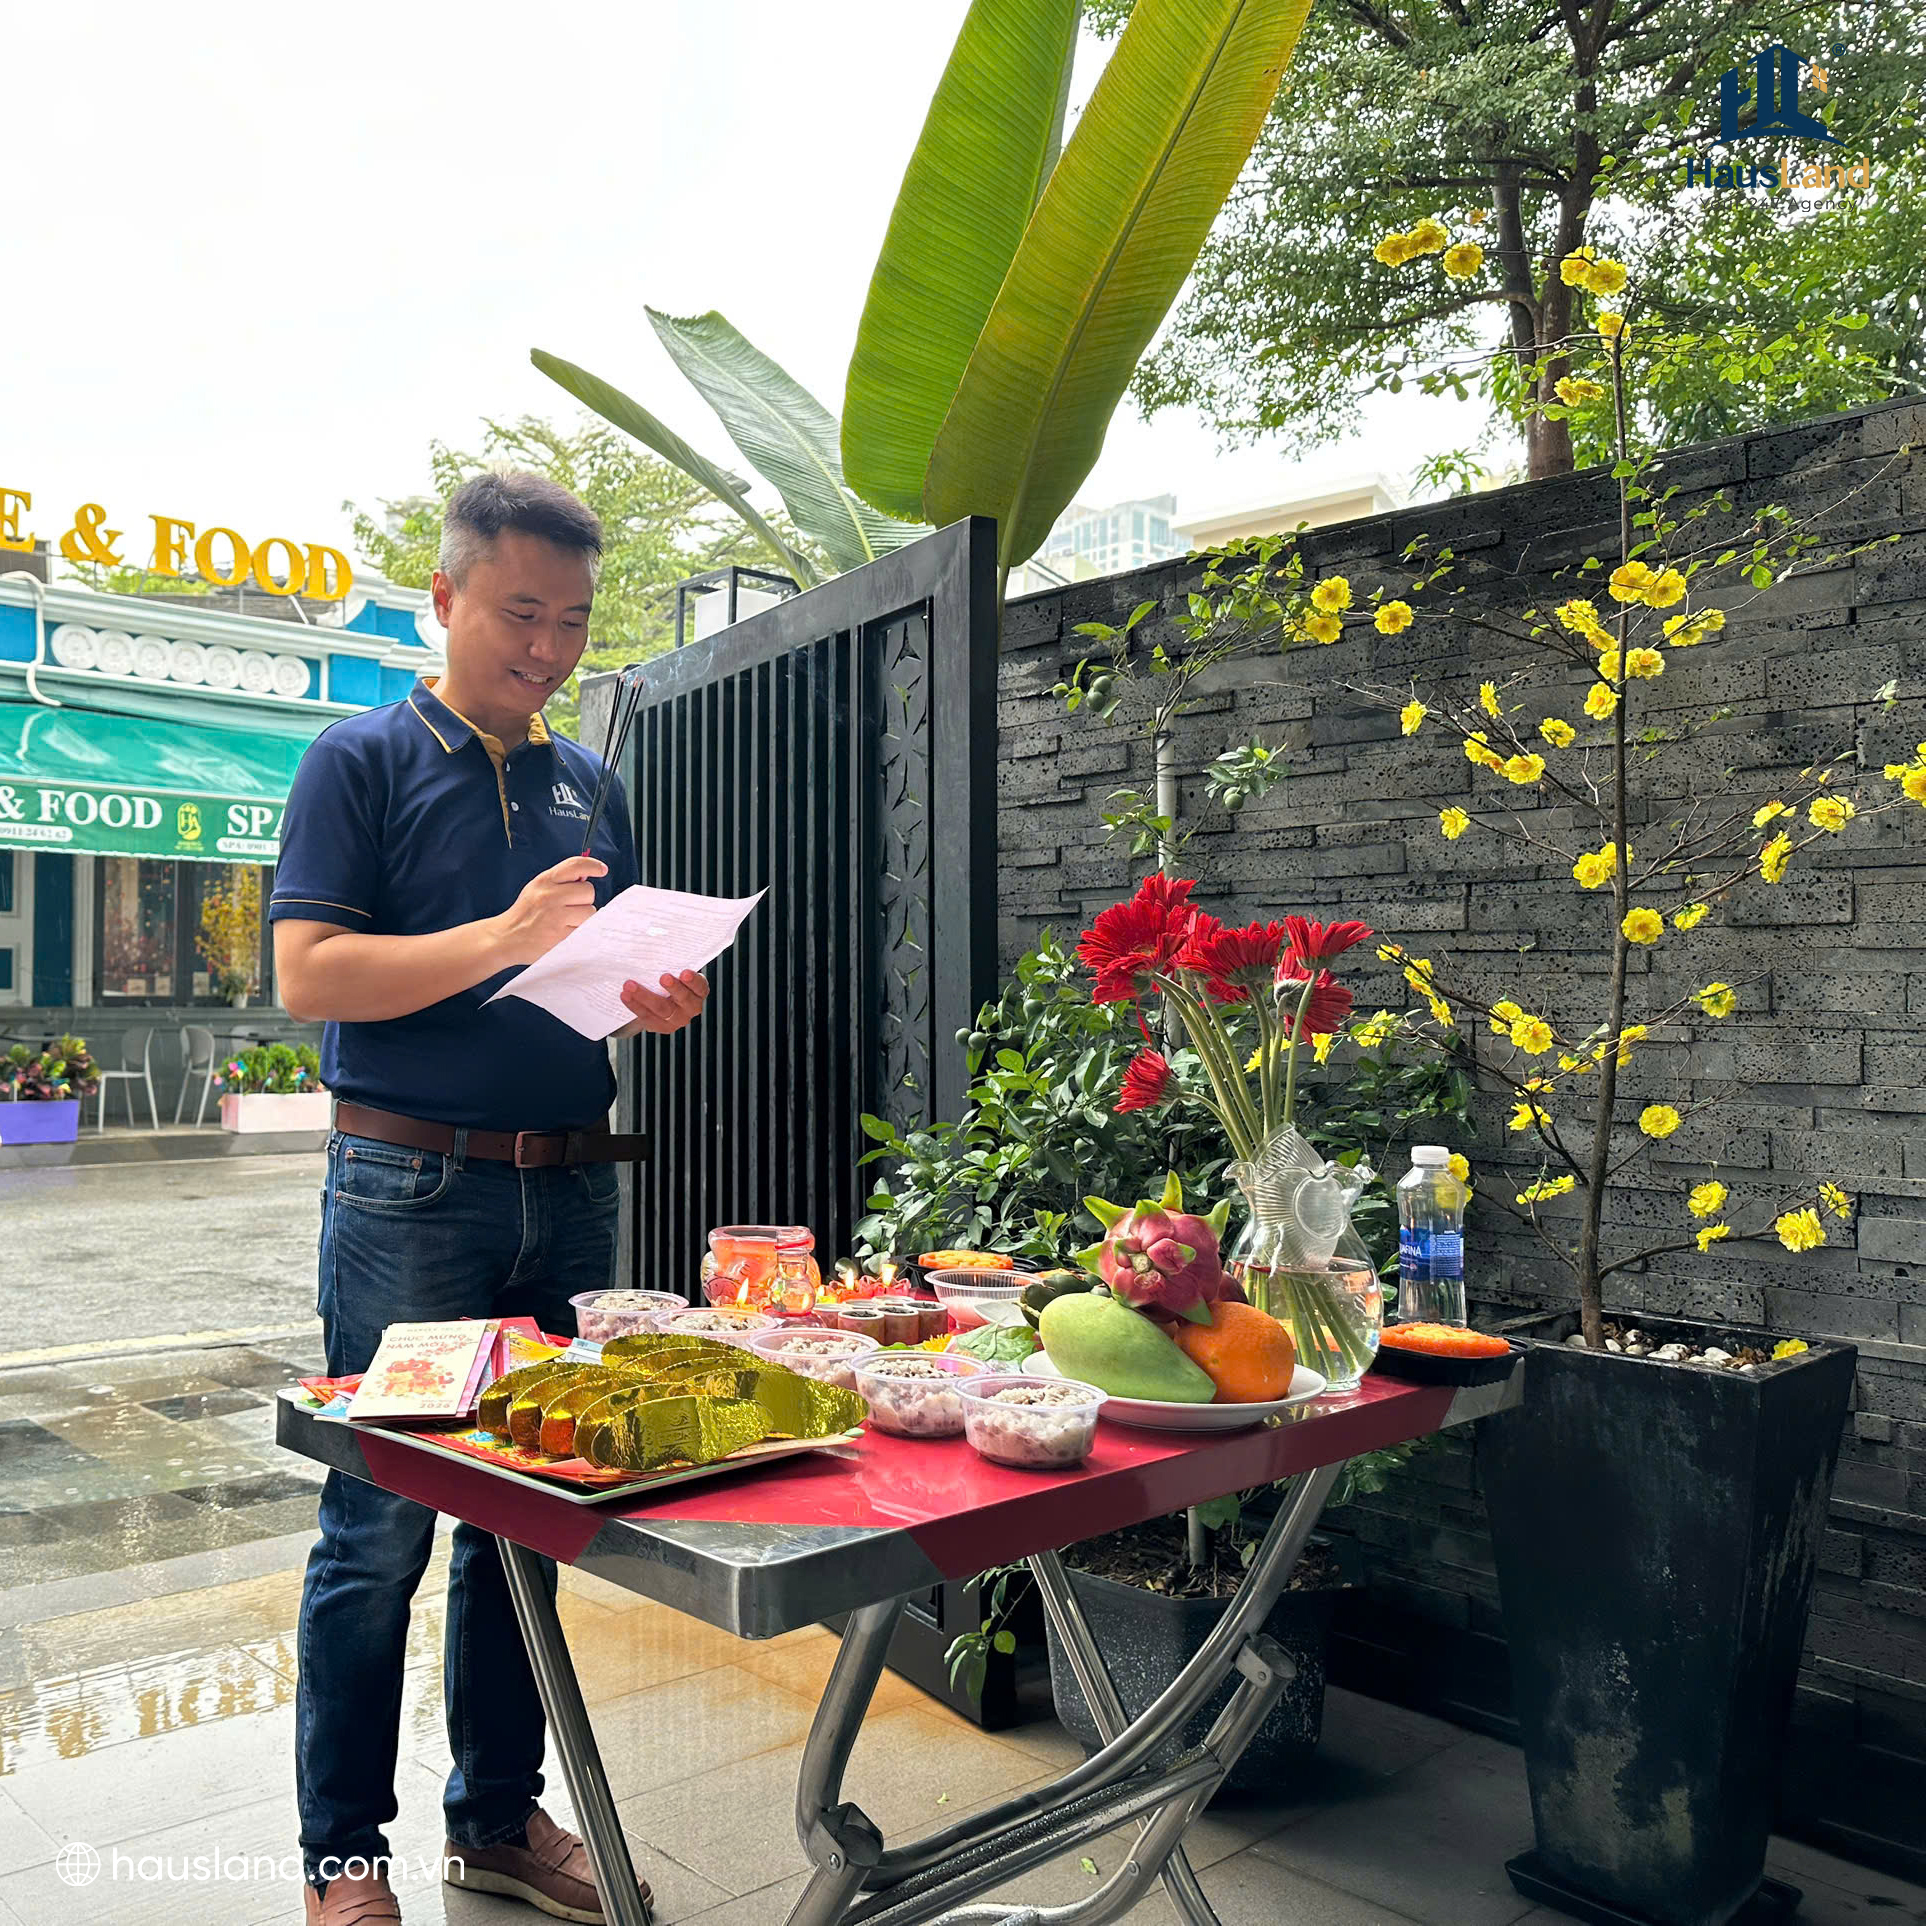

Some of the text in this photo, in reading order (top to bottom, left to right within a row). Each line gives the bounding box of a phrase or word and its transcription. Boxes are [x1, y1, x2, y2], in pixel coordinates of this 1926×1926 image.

[59, 503, 125, 567] &
[148, 514, 354, 600] FOOD
[0, 785, 25, 820] &
[36, 789, 163, 829] FOOD
[548, 806, 592, 821] HausLan
